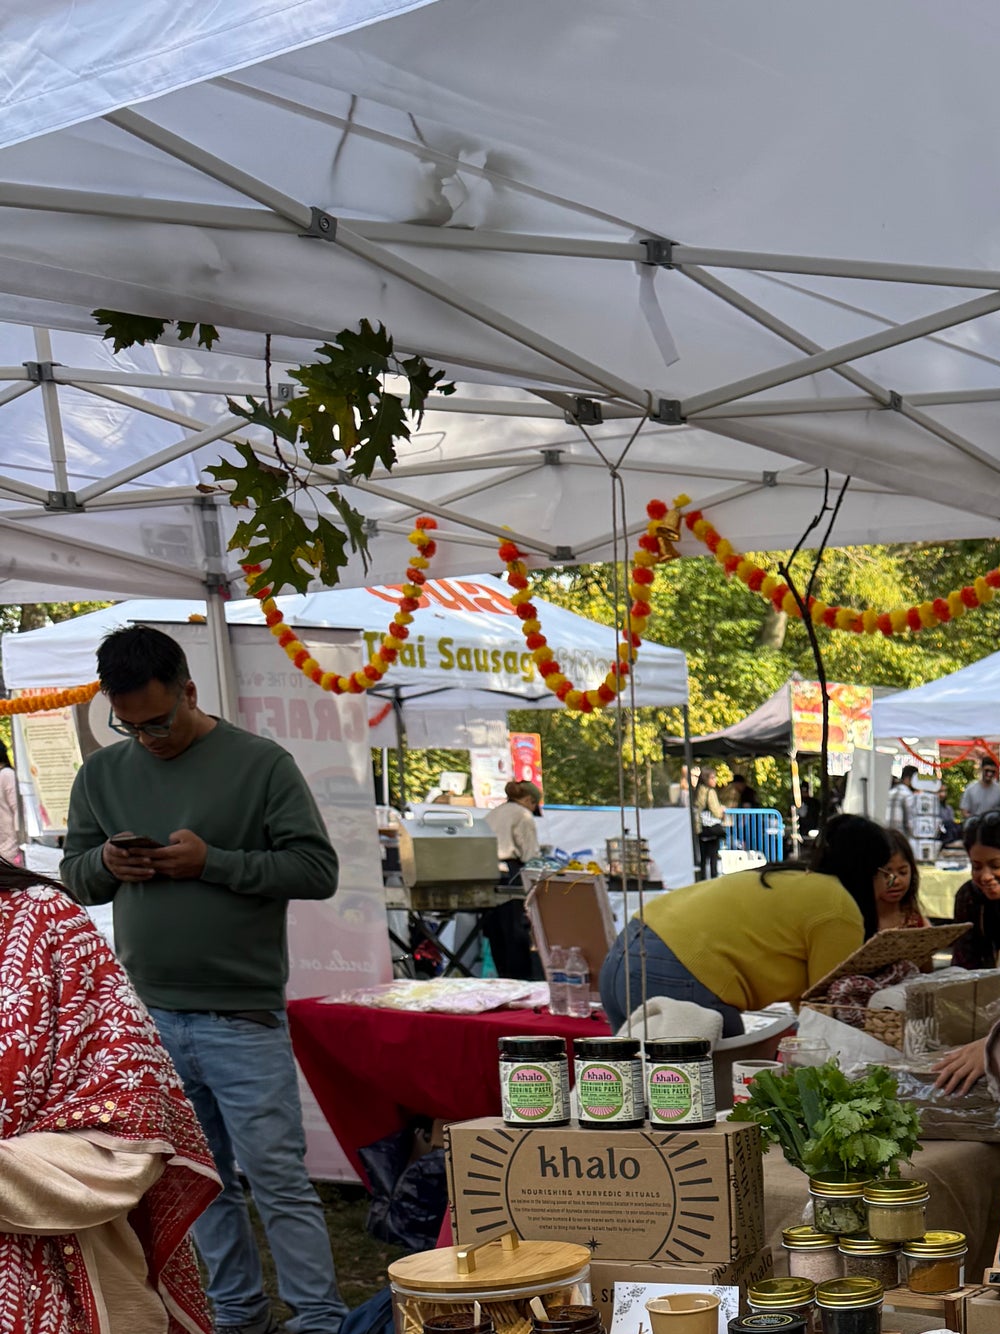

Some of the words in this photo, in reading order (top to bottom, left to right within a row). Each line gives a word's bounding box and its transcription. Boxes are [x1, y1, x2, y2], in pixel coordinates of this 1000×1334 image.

[517, 1073, 542, 1081] khalo
[587, 1071, 612, 1080] khalo
[656, 1074, 680, 1083] khalo
[537, 1145, 641, 1180] khalo
[521, 1188, 573, 1196] NOURISHING
[576, 1190, 622, 1198] AYURVEDIC
